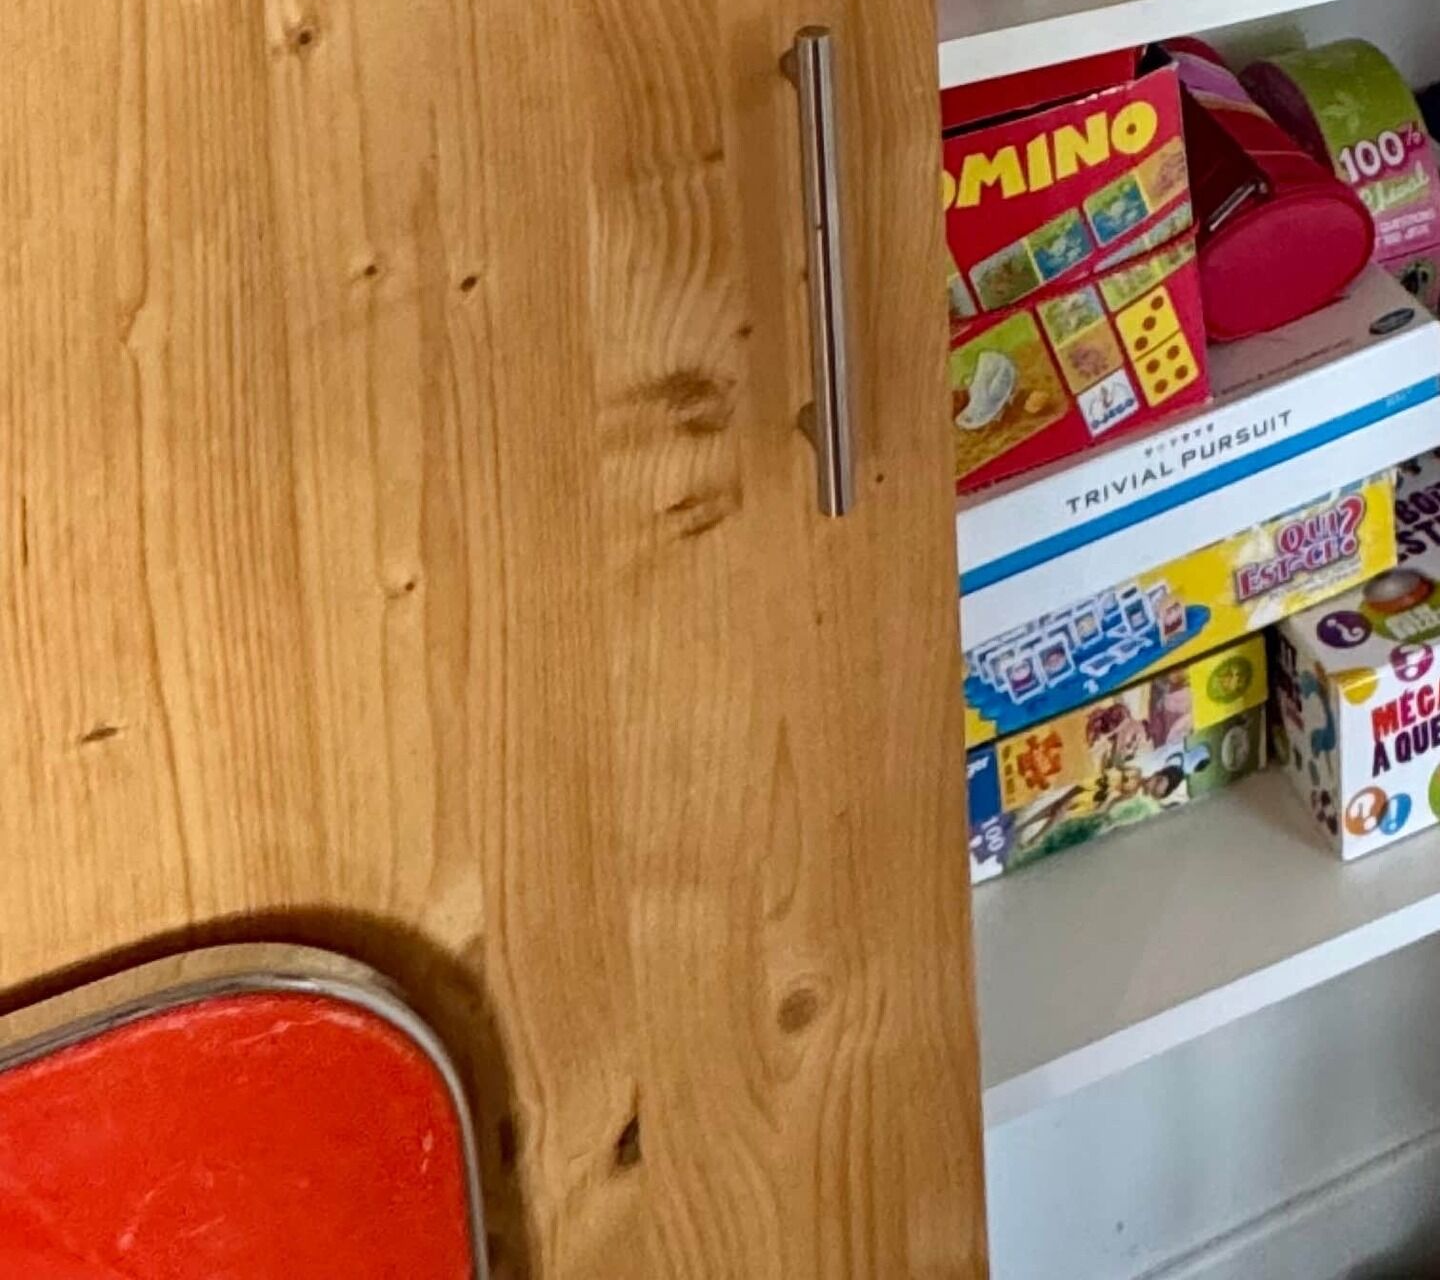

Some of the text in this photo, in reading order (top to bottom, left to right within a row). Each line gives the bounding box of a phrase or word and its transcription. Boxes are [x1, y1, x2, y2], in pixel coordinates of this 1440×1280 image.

[1066, 409, 1292, 514] TRIVIAL PURSUIT
[981, 814, 1005, 852] 100
